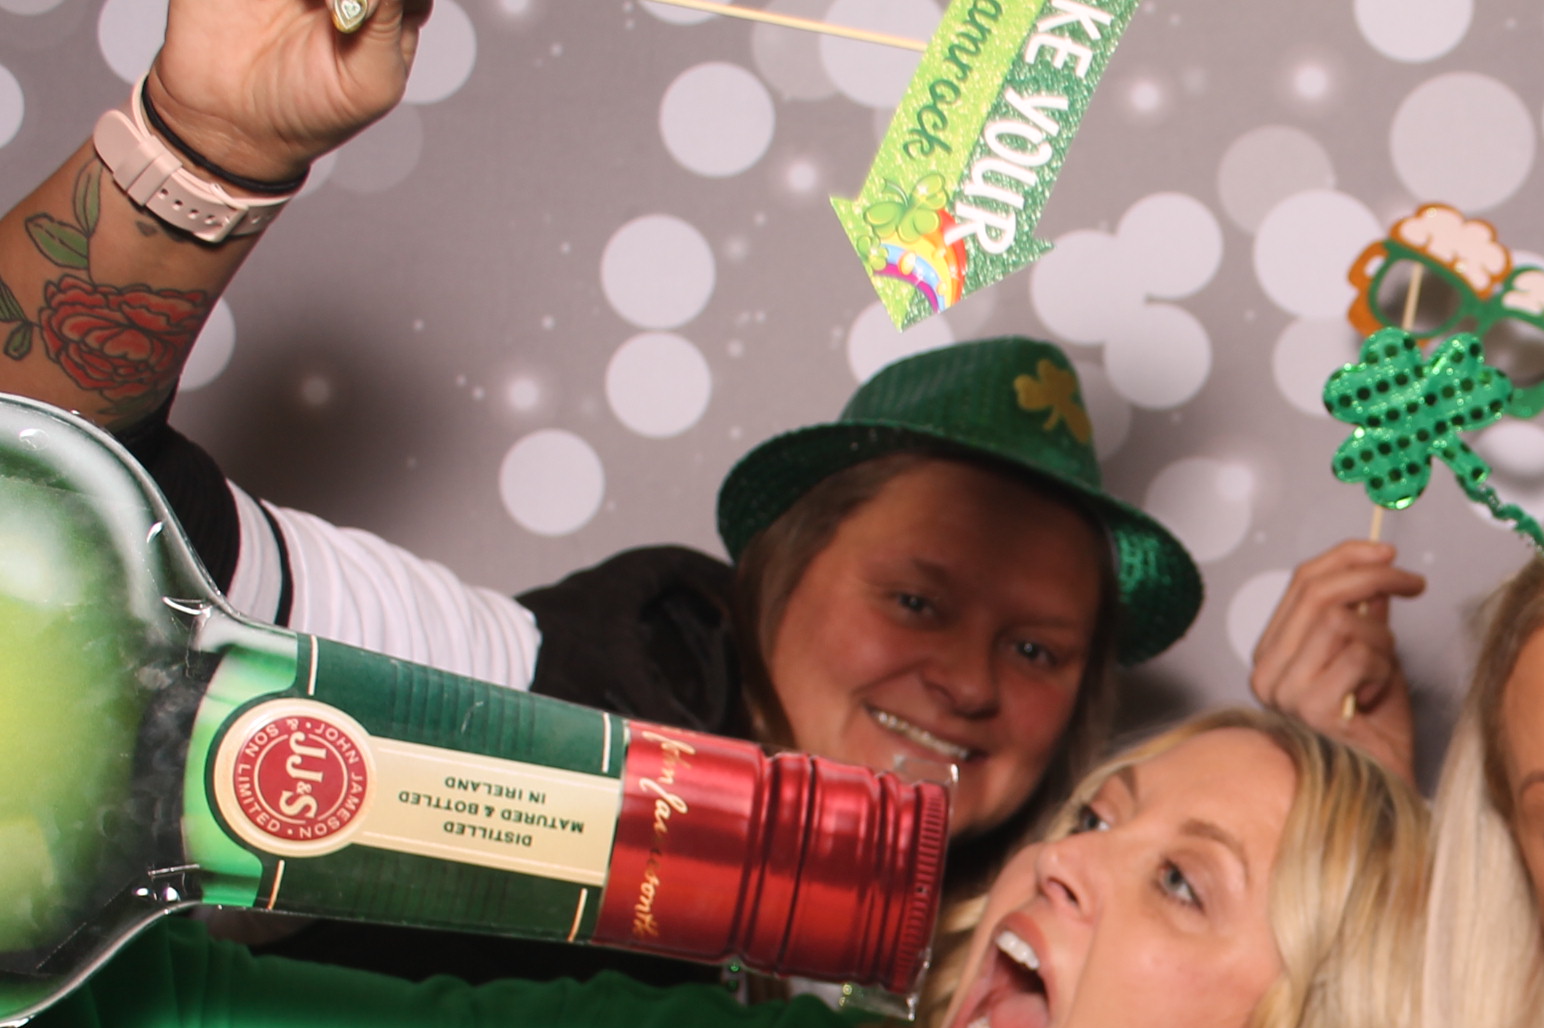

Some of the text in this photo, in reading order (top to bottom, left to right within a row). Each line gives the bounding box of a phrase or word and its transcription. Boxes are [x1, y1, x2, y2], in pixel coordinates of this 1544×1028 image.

[944, 88, 1068, 254] YOUR
[245, 724, 279, 757] SON
[300, 723, 363, 838] JOHN JAMESON
[444, 776, 546, 804] IN IRELAND
[238, 764, 281, 832] LIMITED
[398, 791, 479, 815] BOTTLED
[443, 820, 533, 847] DISTILLED
[501, 808, 585, 834] MATURED
